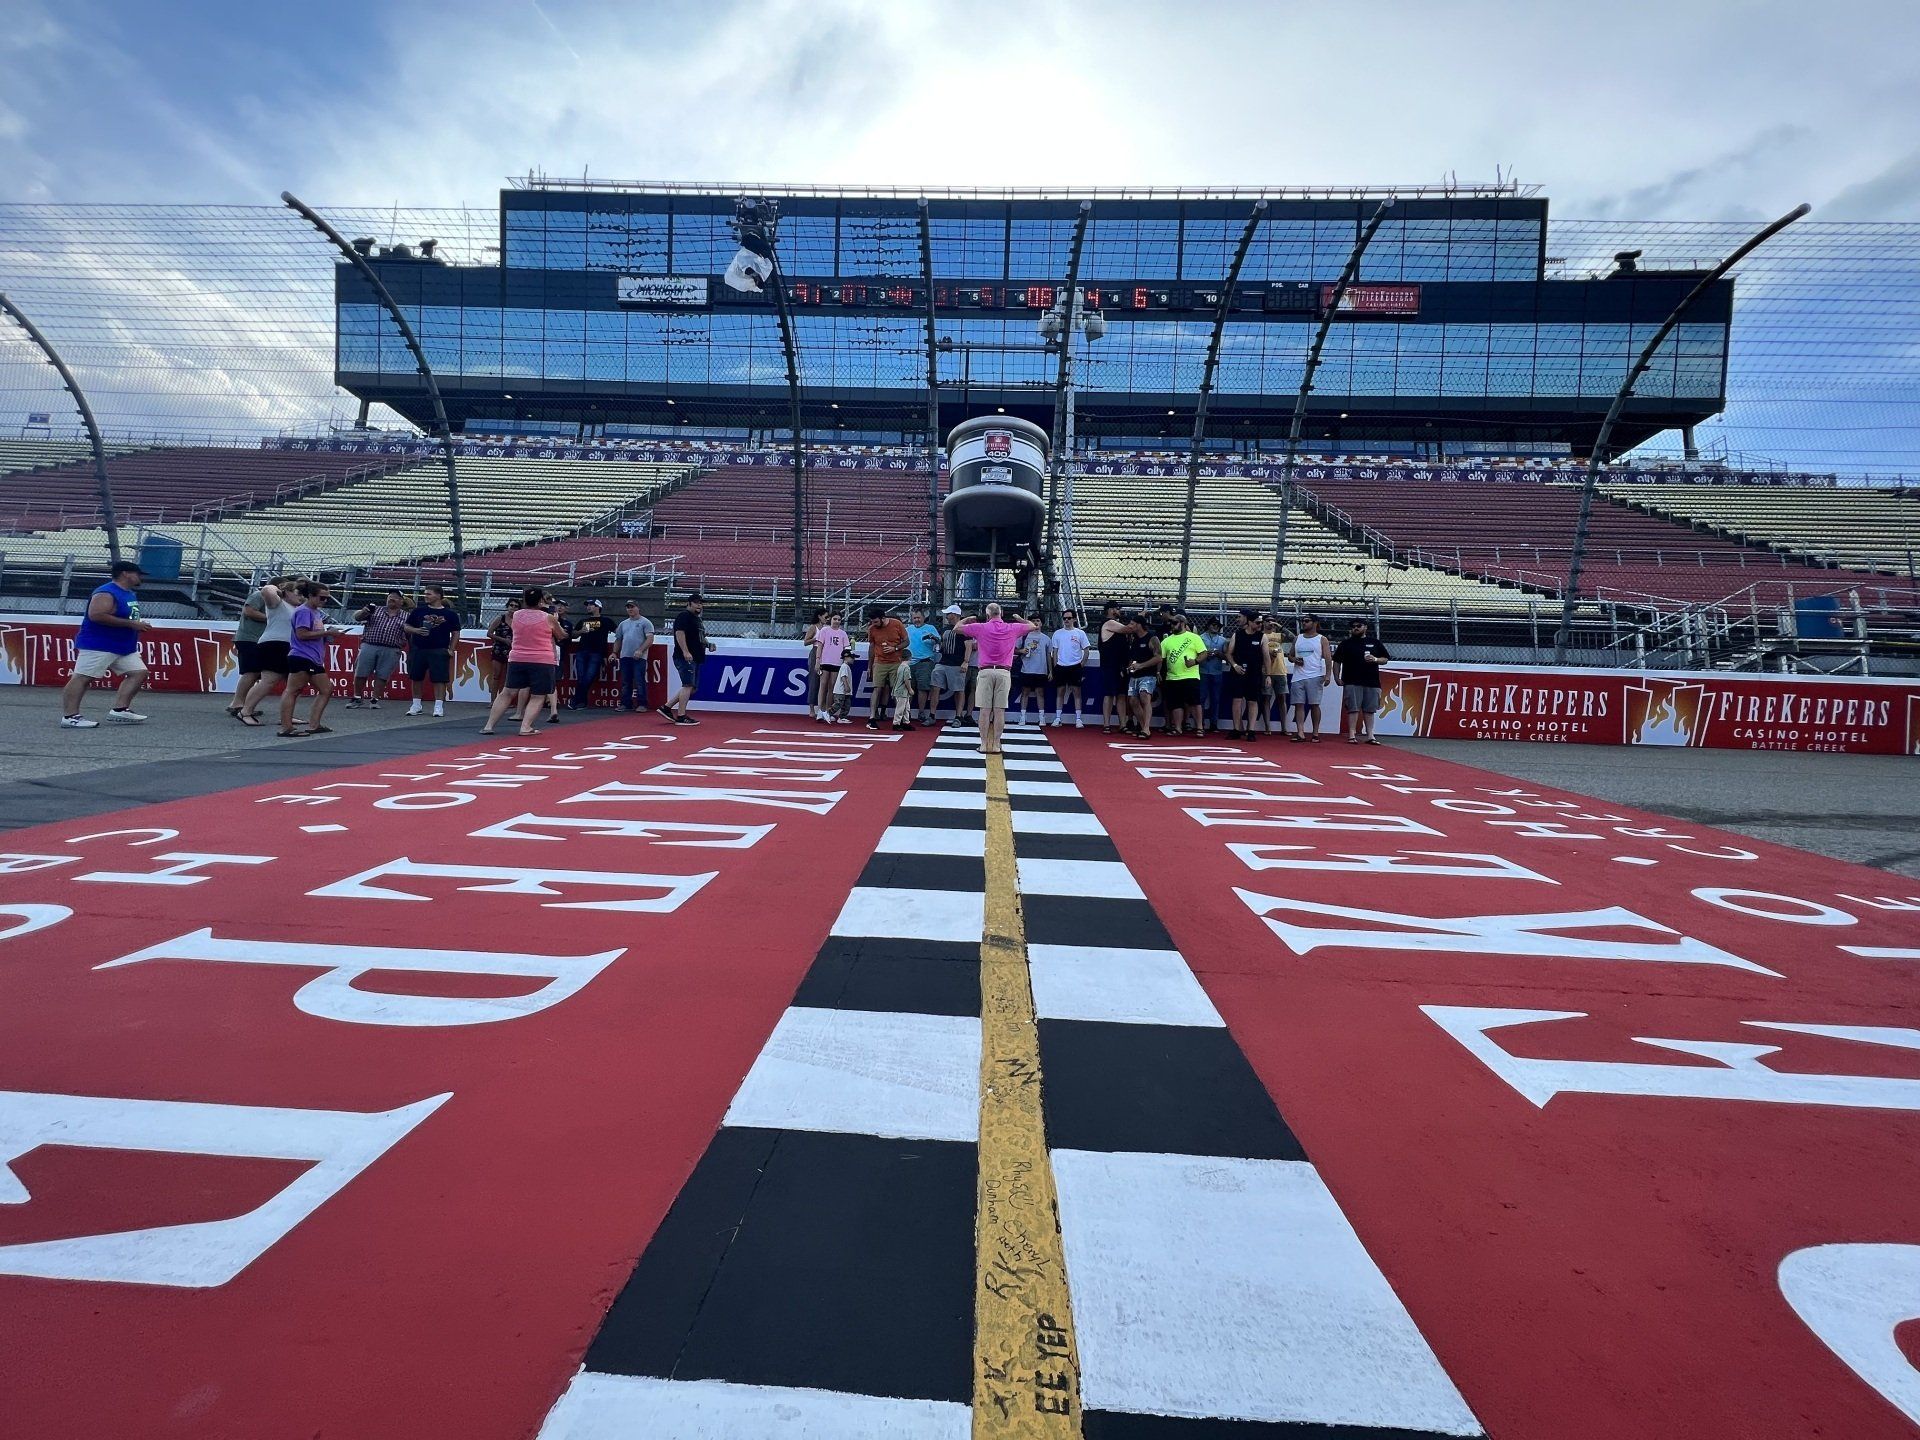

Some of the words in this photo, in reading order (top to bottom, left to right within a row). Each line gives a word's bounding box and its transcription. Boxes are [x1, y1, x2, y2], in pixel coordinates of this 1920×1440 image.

[1206, 294, 1218, 303] 10
[1445, 682, 1608, 717] FIREKEEPERS
[1718, 692, 1890, 726] FIREKEEPERS
[1459, 718, 1522, 730] CASINO
[1537, 721, 1588, 733] HOTEL
[1477, 732, 1520, 741] BATTLE
[1530, 733, 1567, 742] CREEK
[1733, 728, 1799, 740] CASINO
[1814, 731, 1868, 742] HOTEL
[1752, 741, 1797, 751] BATTLE
[1807, 743, 1847, 752] CREEK
[1003, 1161, 1032, 1192] Rhys
[986, 1179, 1006, 1225] Dunham
